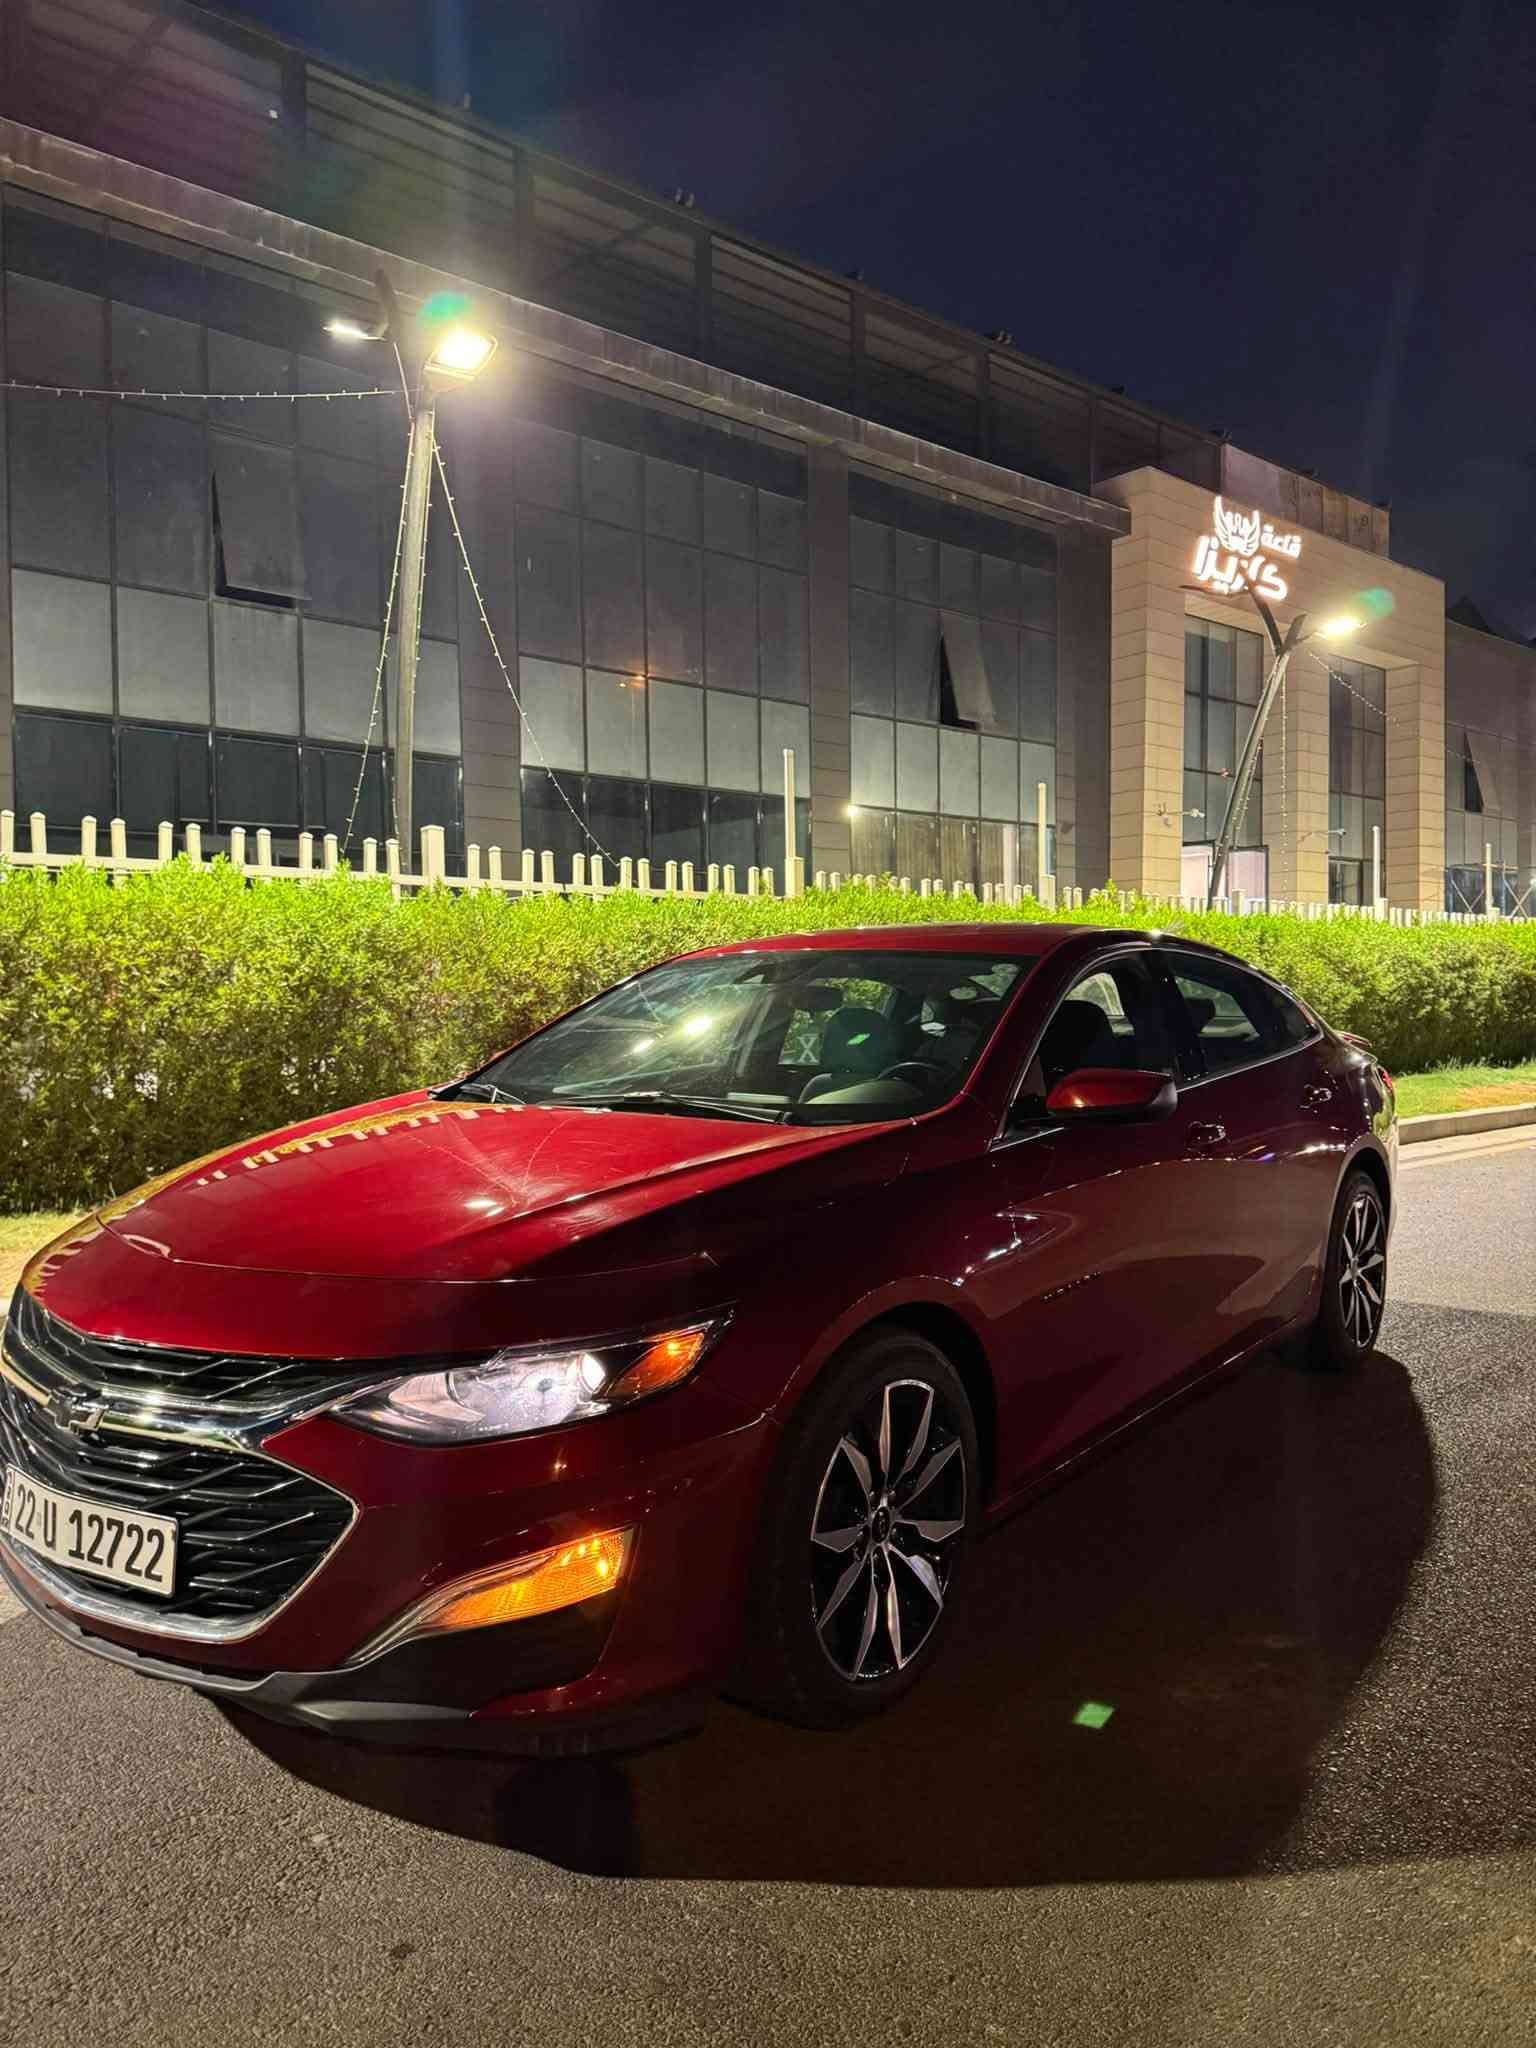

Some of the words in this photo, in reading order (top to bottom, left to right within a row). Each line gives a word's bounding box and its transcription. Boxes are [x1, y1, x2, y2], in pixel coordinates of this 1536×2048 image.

[1261, 525, 1301, 558] قاعة
[15, 1484, 35, 1540] 22
[43, 1498, 57, 1550] U
[68, 1509, 165, 1582] 12722
